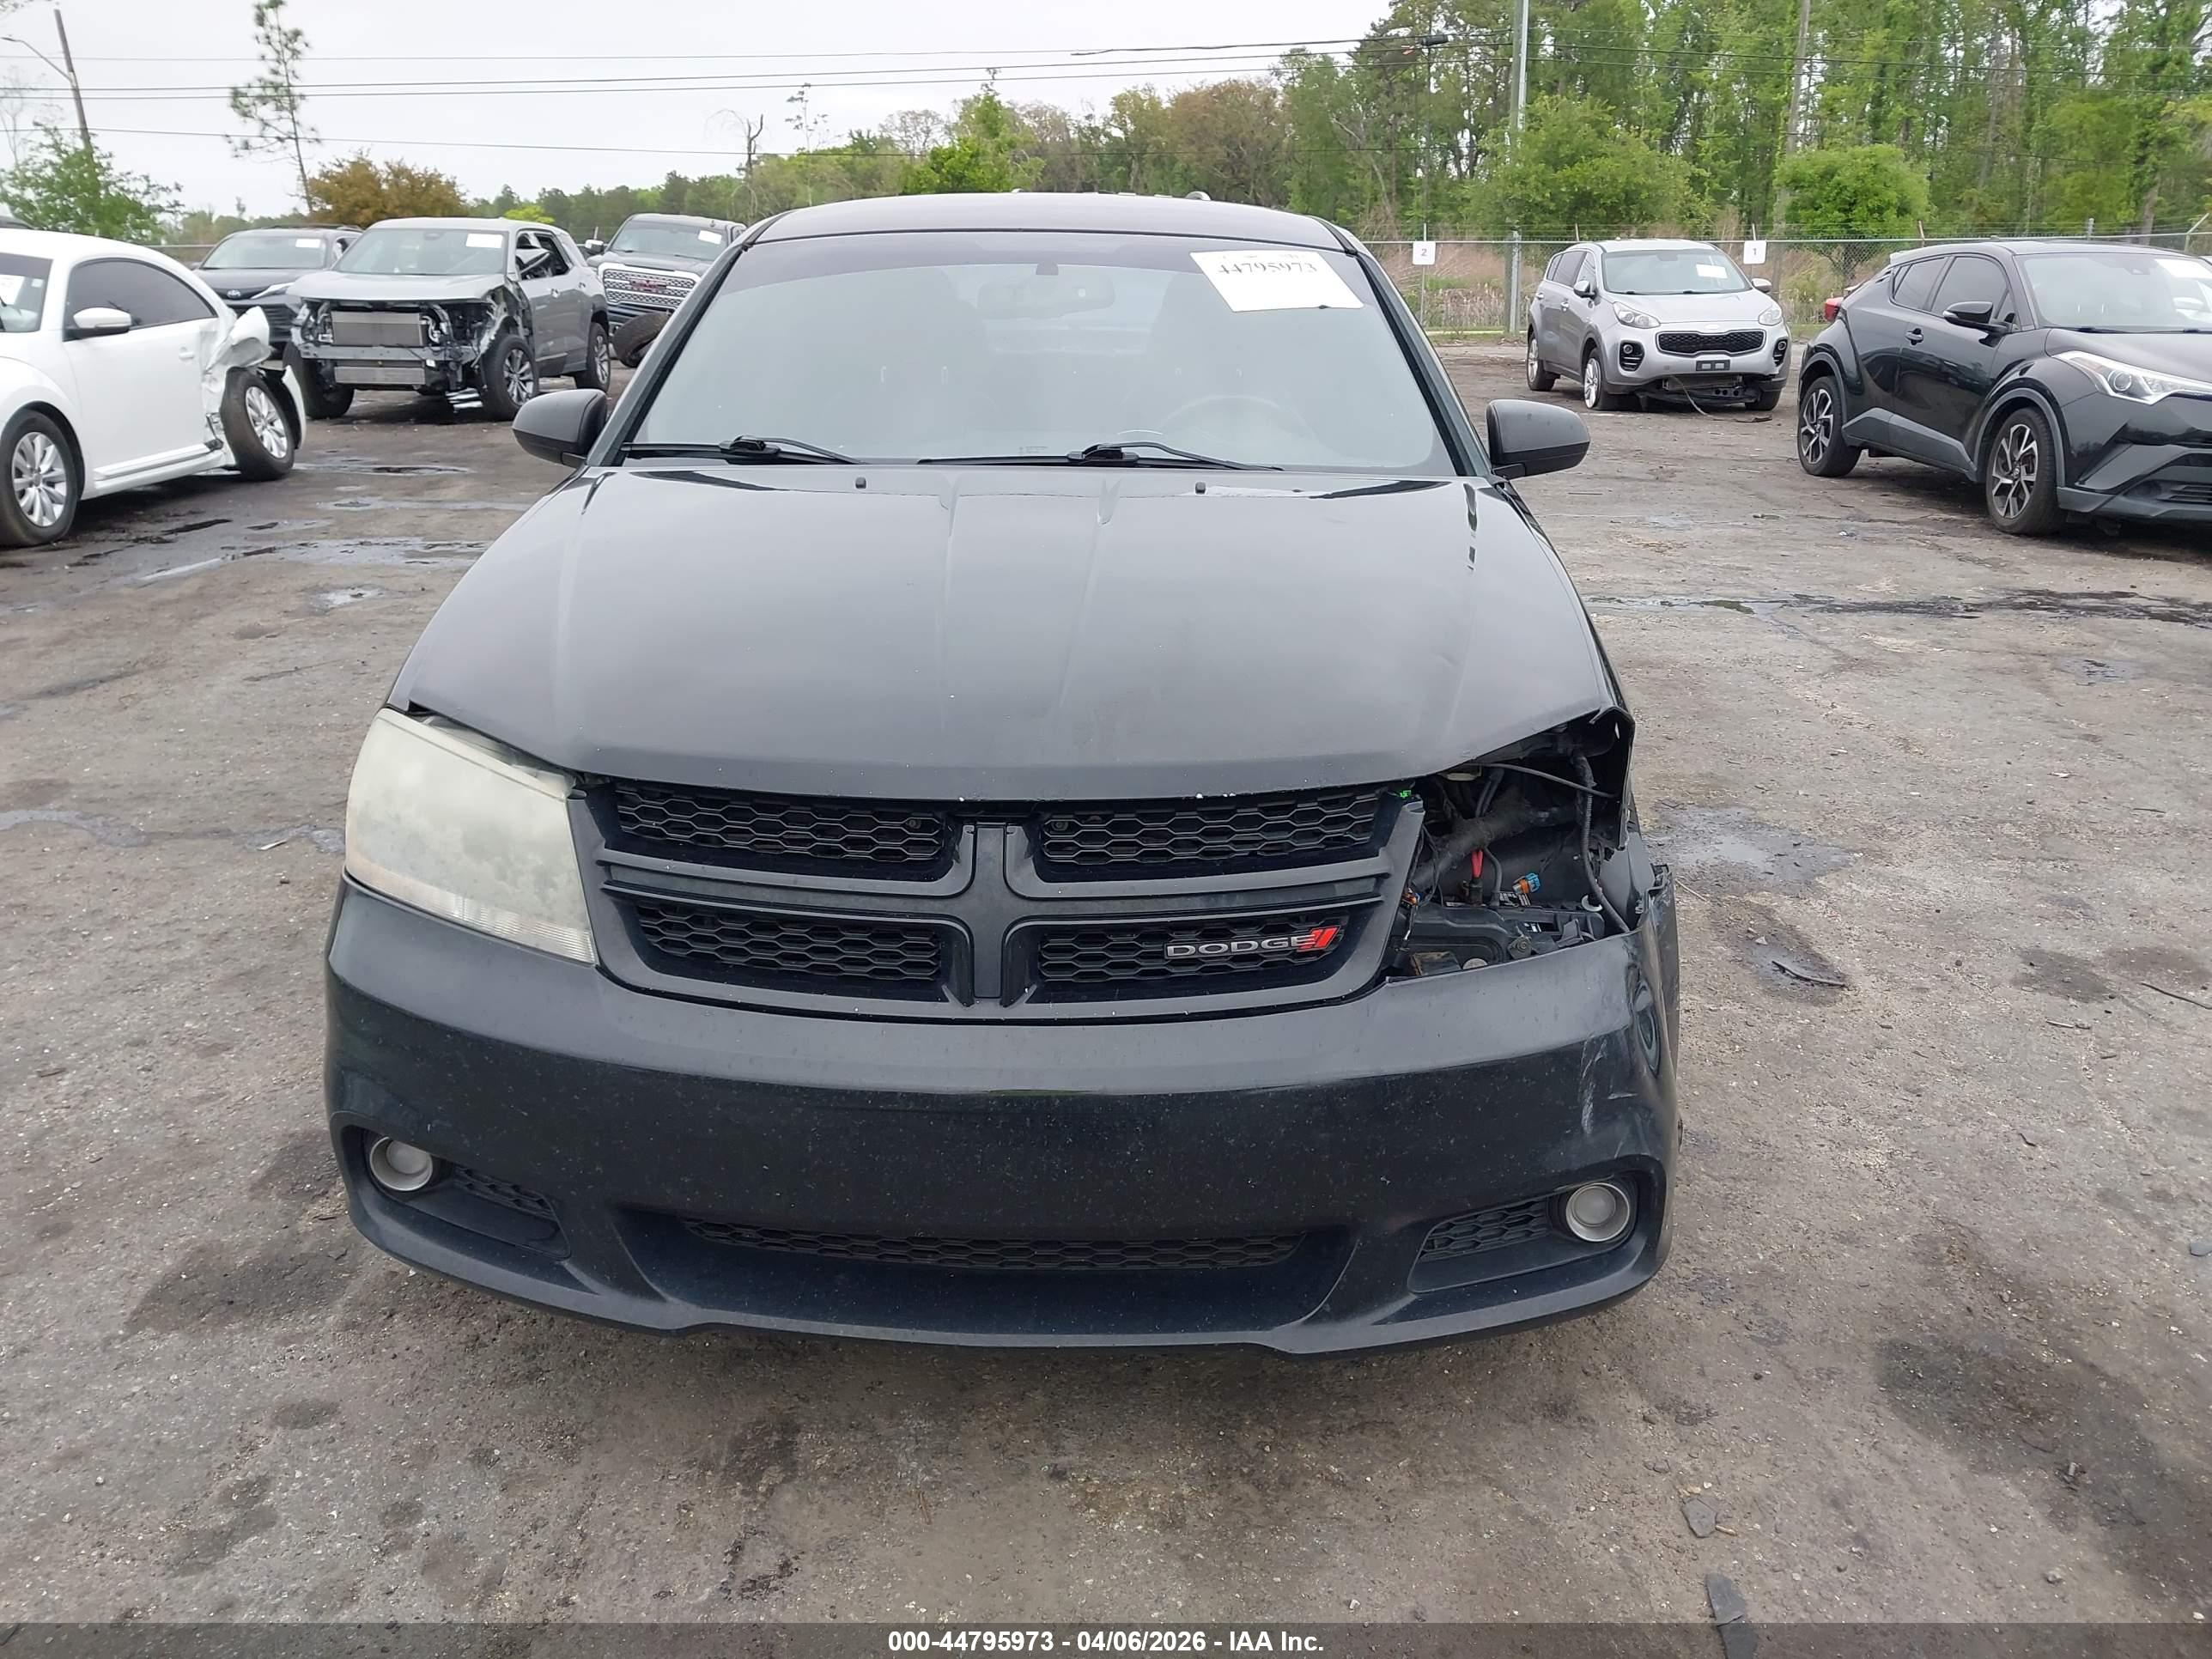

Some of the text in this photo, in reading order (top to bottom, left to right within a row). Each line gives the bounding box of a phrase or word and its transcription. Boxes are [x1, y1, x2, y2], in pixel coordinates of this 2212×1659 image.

[1420, 248, 1428, 257] 2
[1218, 261, 1318, 275] 44795973
[1166, 933, 1316, 957] DODGE
